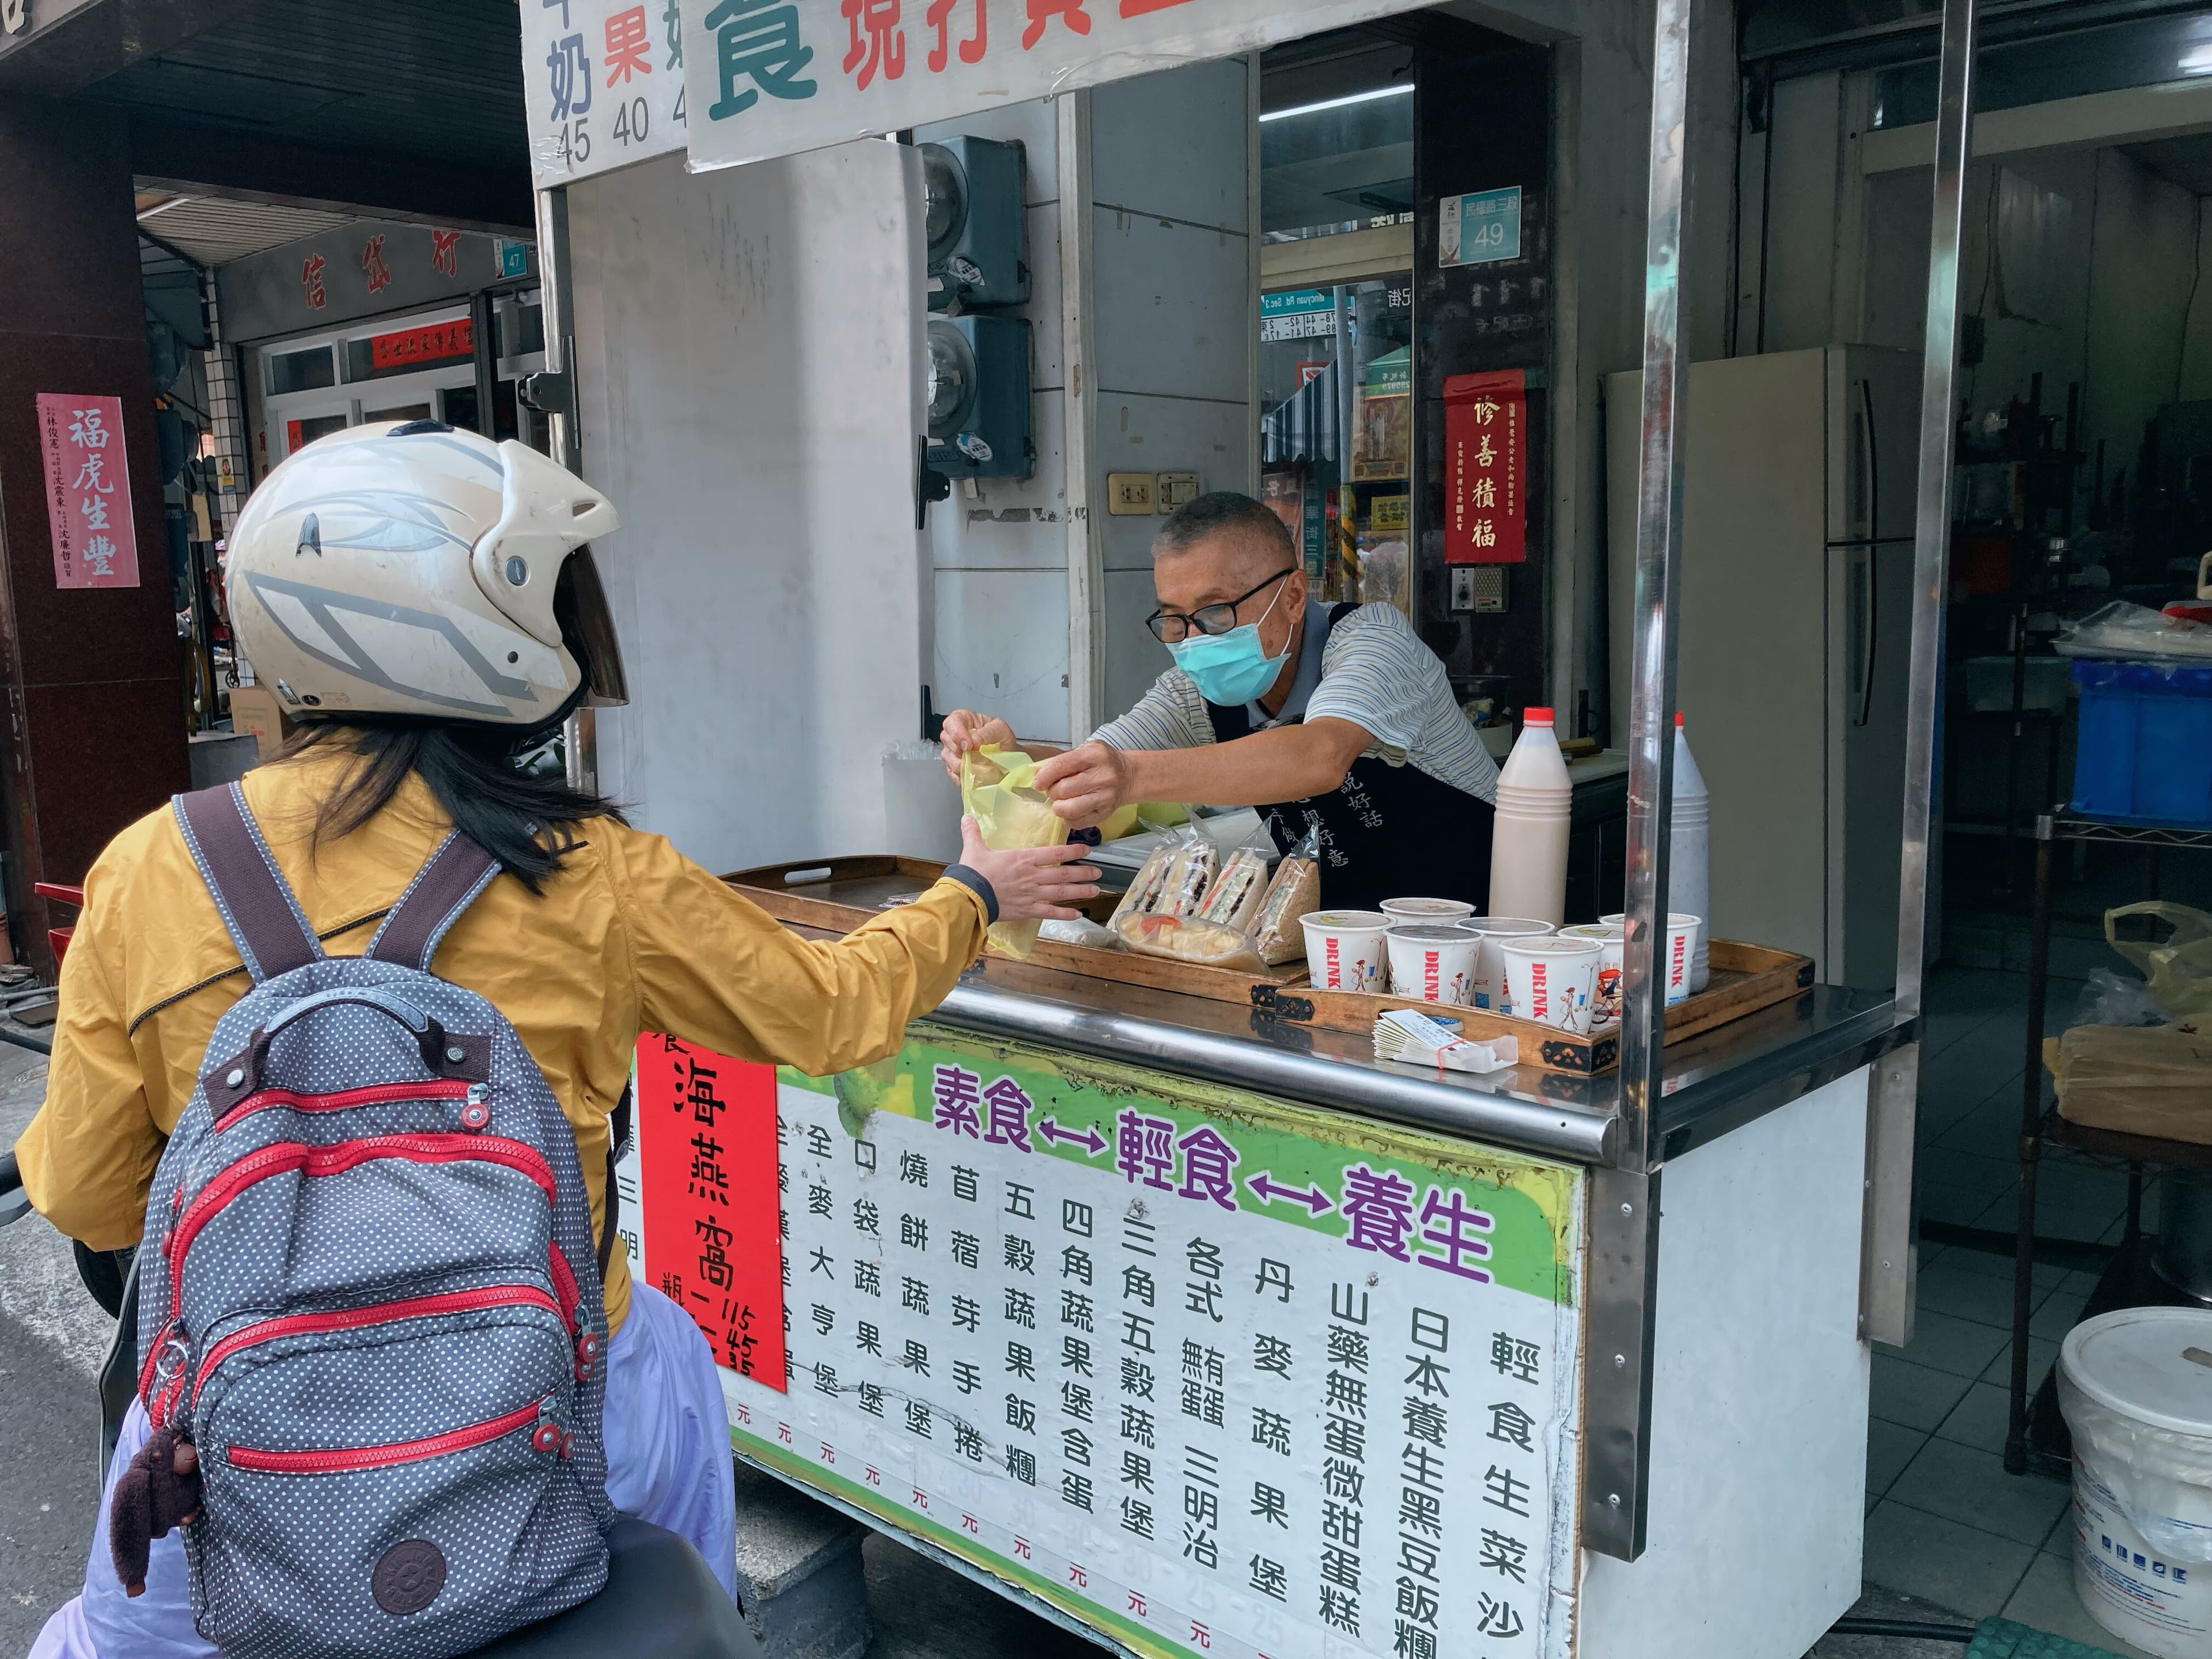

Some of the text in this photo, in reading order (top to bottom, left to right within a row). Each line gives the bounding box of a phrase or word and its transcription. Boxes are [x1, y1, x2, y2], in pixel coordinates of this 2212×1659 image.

[605, 5, 652, 88] 果
[706, 0, 818, 122] 食
[556, 118, 590, 167] 45
[613, 96, 649, 147] 40
[509, 253, 518, 267] 47
[1474, 222, 1503, 247] 49
[68, 408, 116, 575] 福虎生豐
[1472, 395, 1500, 548] 修善積福
[1293, 797, 1349, 867] 想好意
[1340, 772, 1383, 828] 說好話
[1326, 937, 1341, 990] DRINK
[1532, 963, 1548, 1020] DRINK
[1672, 935, 1686, 988] DRINK
[934, 1067, 1031, 1153] 素食
[1118, 1111, 1237, 1211] 輕食
[808, 1124, 839, 1398] 全麥大亨堡
[1343, 1167, 1490, 1283] 養生
[854, 1139, 887, 1418] 口袋蔬果堡
[900, 1150, 935, 1440] 燒餅蔬果堡
[1003, 1181, 1036, 1486] 五穀蔬果飯糰
[1061, 1199, 1094, 1514] 四角蔬果堡含蛋
[738, 1404, 750, 1424] 元
[1120, 1218, 1156, 1540] 三角五穀蔬果堡
[779, 1422, 791, 1443] 元
[821, 1442, 835, 1463] 元
[1249, 1258, 1294, 1603] 丹麥蔬果堡
[1319, 1282, 1370, 1638] 山藥無蛋微甜蛋糕
[866, 1464, 880, 1486] 元
[1393, 1308, 1450, 1659] 日本養生黑豆飯糰
[1477, 1332, 1540, 1659] 輕食生菜沙
[1014, 1535, 1031, 1560] 元
[1070, 1563, 1087, 1588] 元
[1128, 1589, 1146, 1617] 元
[1191, 1620, 1210, 1649] 元
